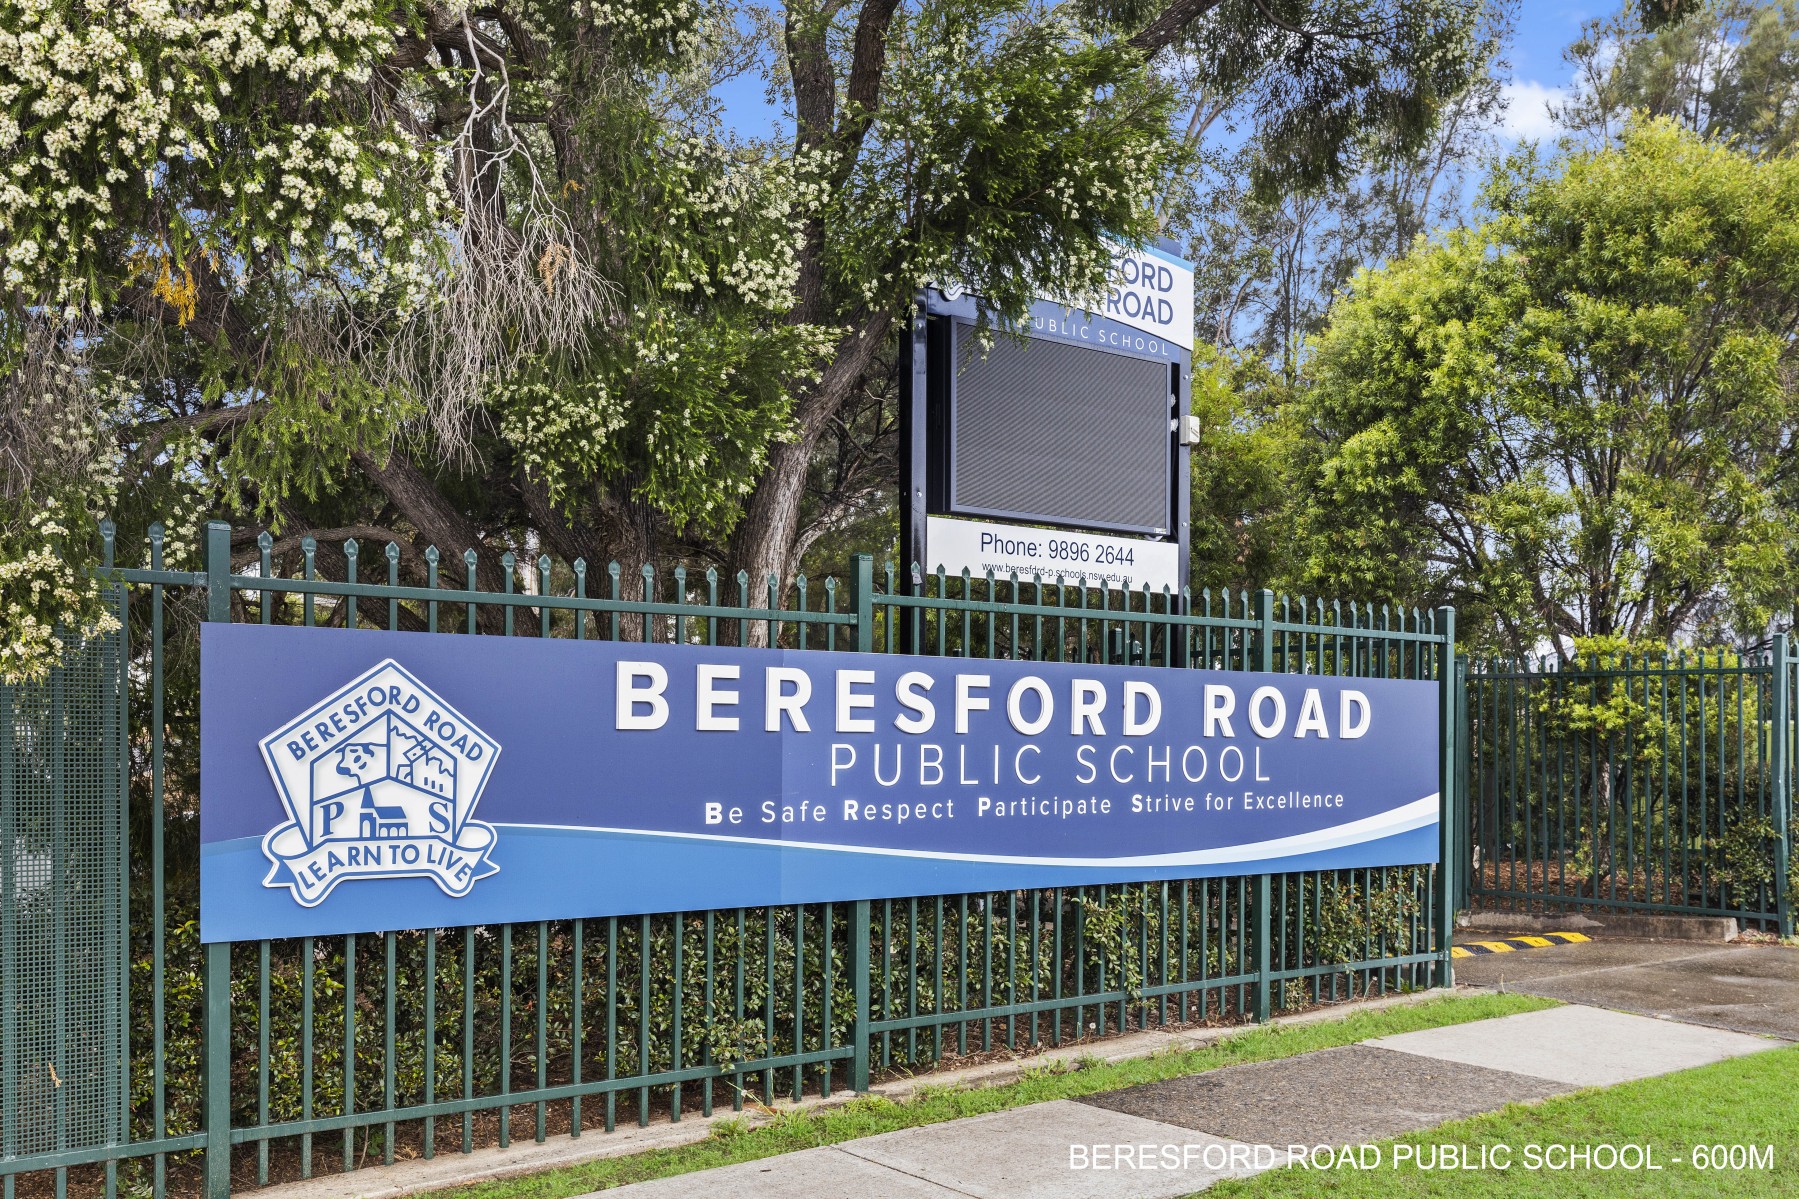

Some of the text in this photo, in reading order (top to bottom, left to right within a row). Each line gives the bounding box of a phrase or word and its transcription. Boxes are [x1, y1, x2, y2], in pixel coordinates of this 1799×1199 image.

[1107, 288, 1174, 325] ROAD
[1034, 316, 1169, 356] UBLIC SCHOOL
[980, 532, 1135, 567] Phone: 9896 2644
[615, 660, 1372, 740] BERESFORD ROAD
[286, 685, 484, 762] BERESFORD ROAD
[830, 743, 1271, 787] PUBLIC SCHOOL
[705, 791, 1345, 825] Be Safe Respect Participate Strive for Excellence
[297, 844, 472, 890] LEARN TO LIVE
